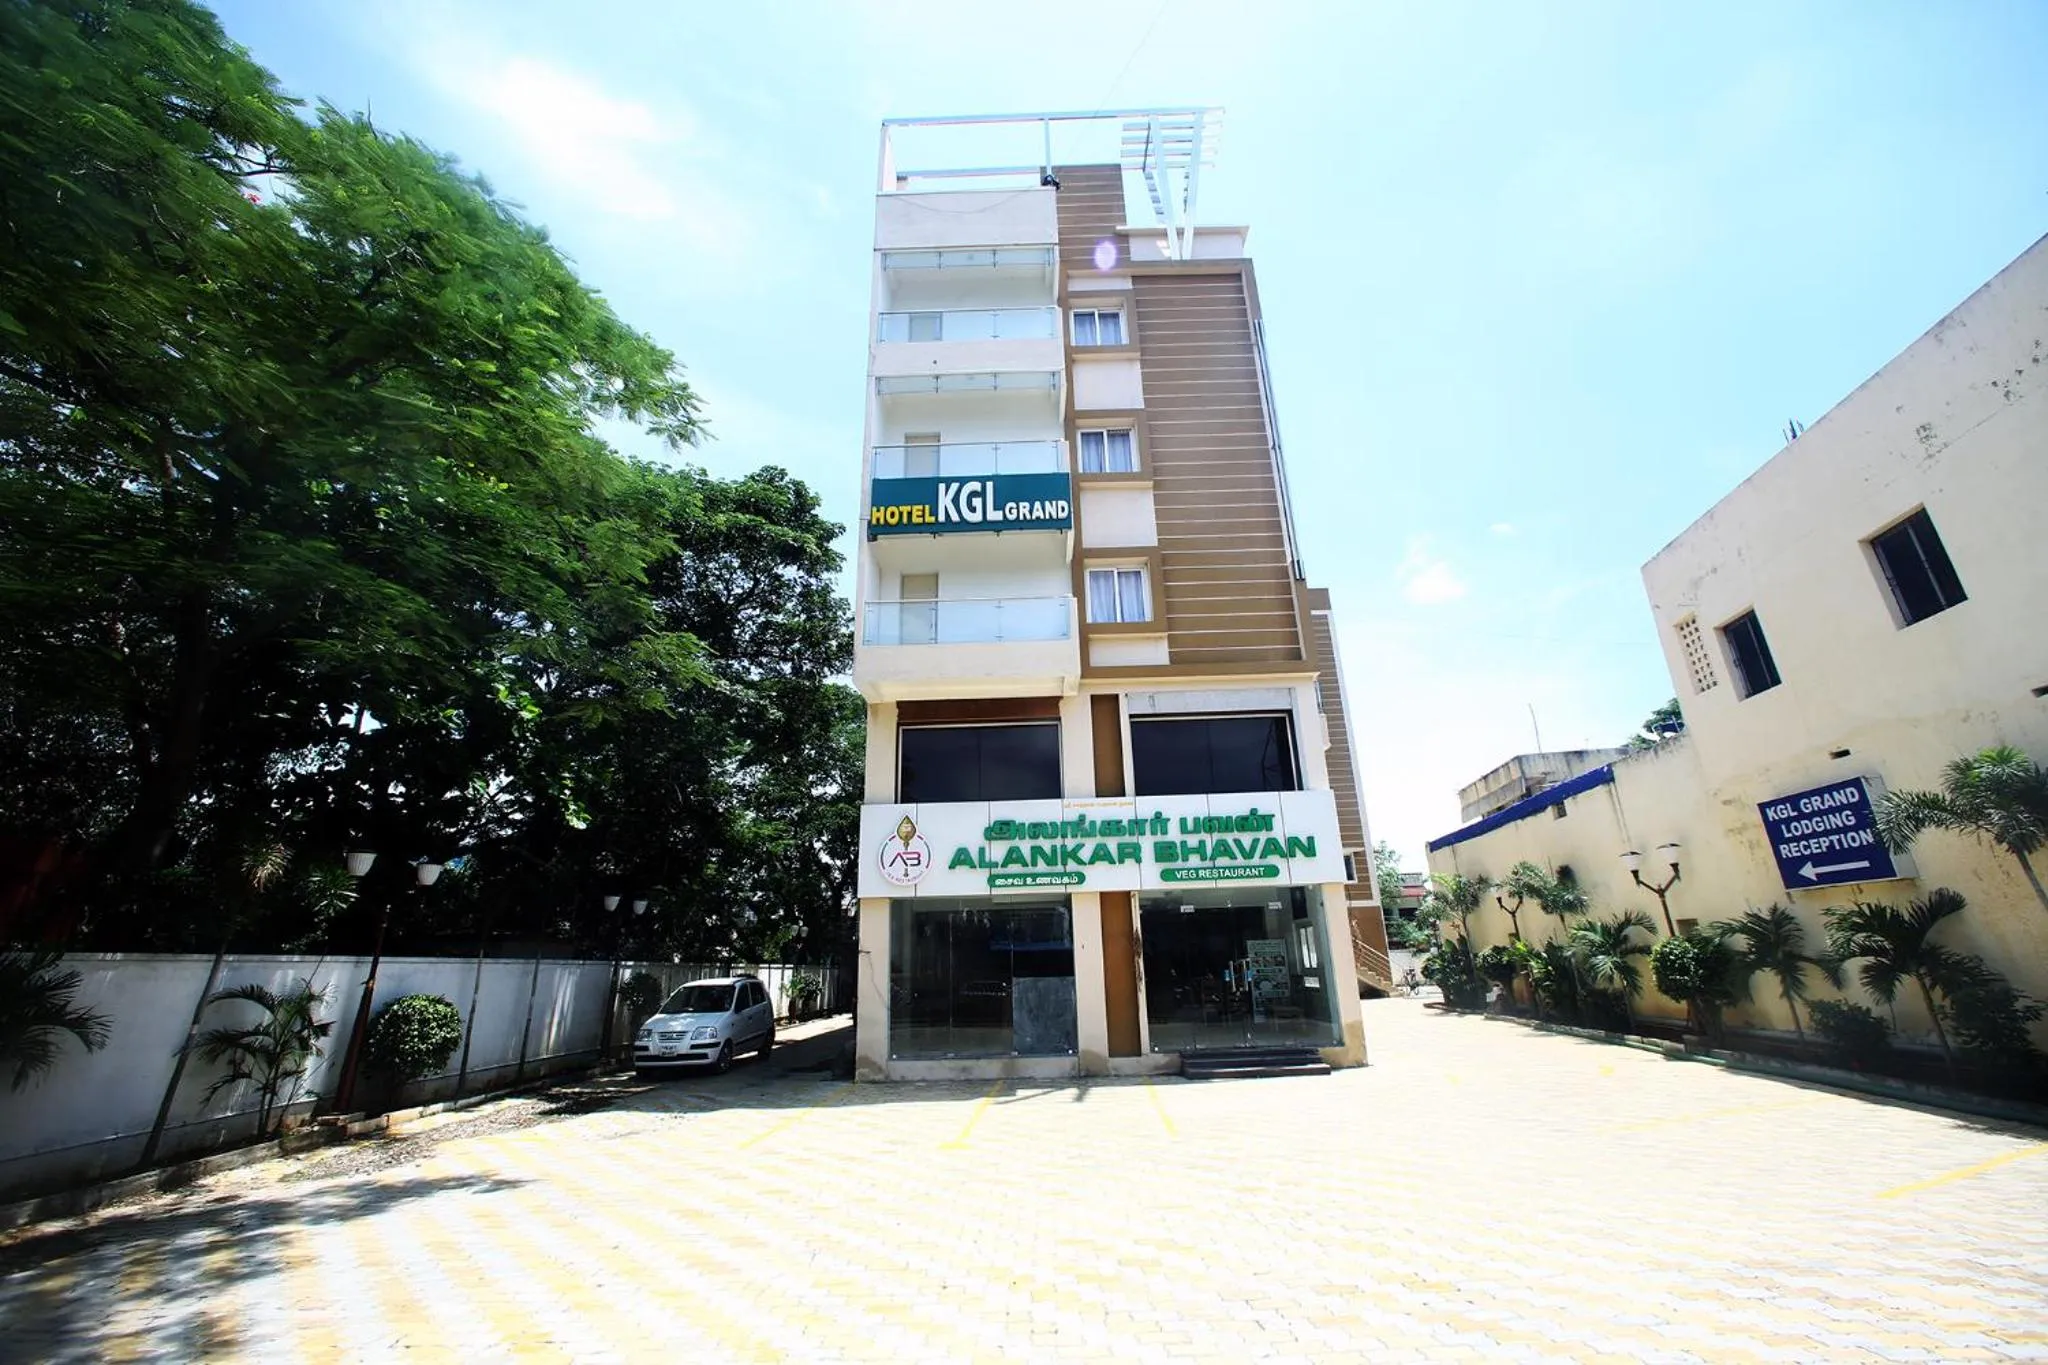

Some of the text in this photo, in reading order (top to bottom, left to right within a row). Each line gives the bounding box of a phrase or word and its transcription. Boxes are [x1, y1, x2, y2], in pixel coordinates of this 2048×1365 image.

[872, 480, 1070, 525] HOTEL KGL GRAND
[1765, 787, 1860, 821] KGL GRAND
[983, 808, 1275, 841] அலங்கார் பவன்
[1781, 810, 1856, 838] LODGING
[948, 836, 1317, 870] ALANKAR BHAVAN
[1779, 828, 1875, 859] RECEPTION
[994, 875, 1078, 886] சைவ உணவகம்
[1175, 867, 1265, 879] VEG RESTAURANT
